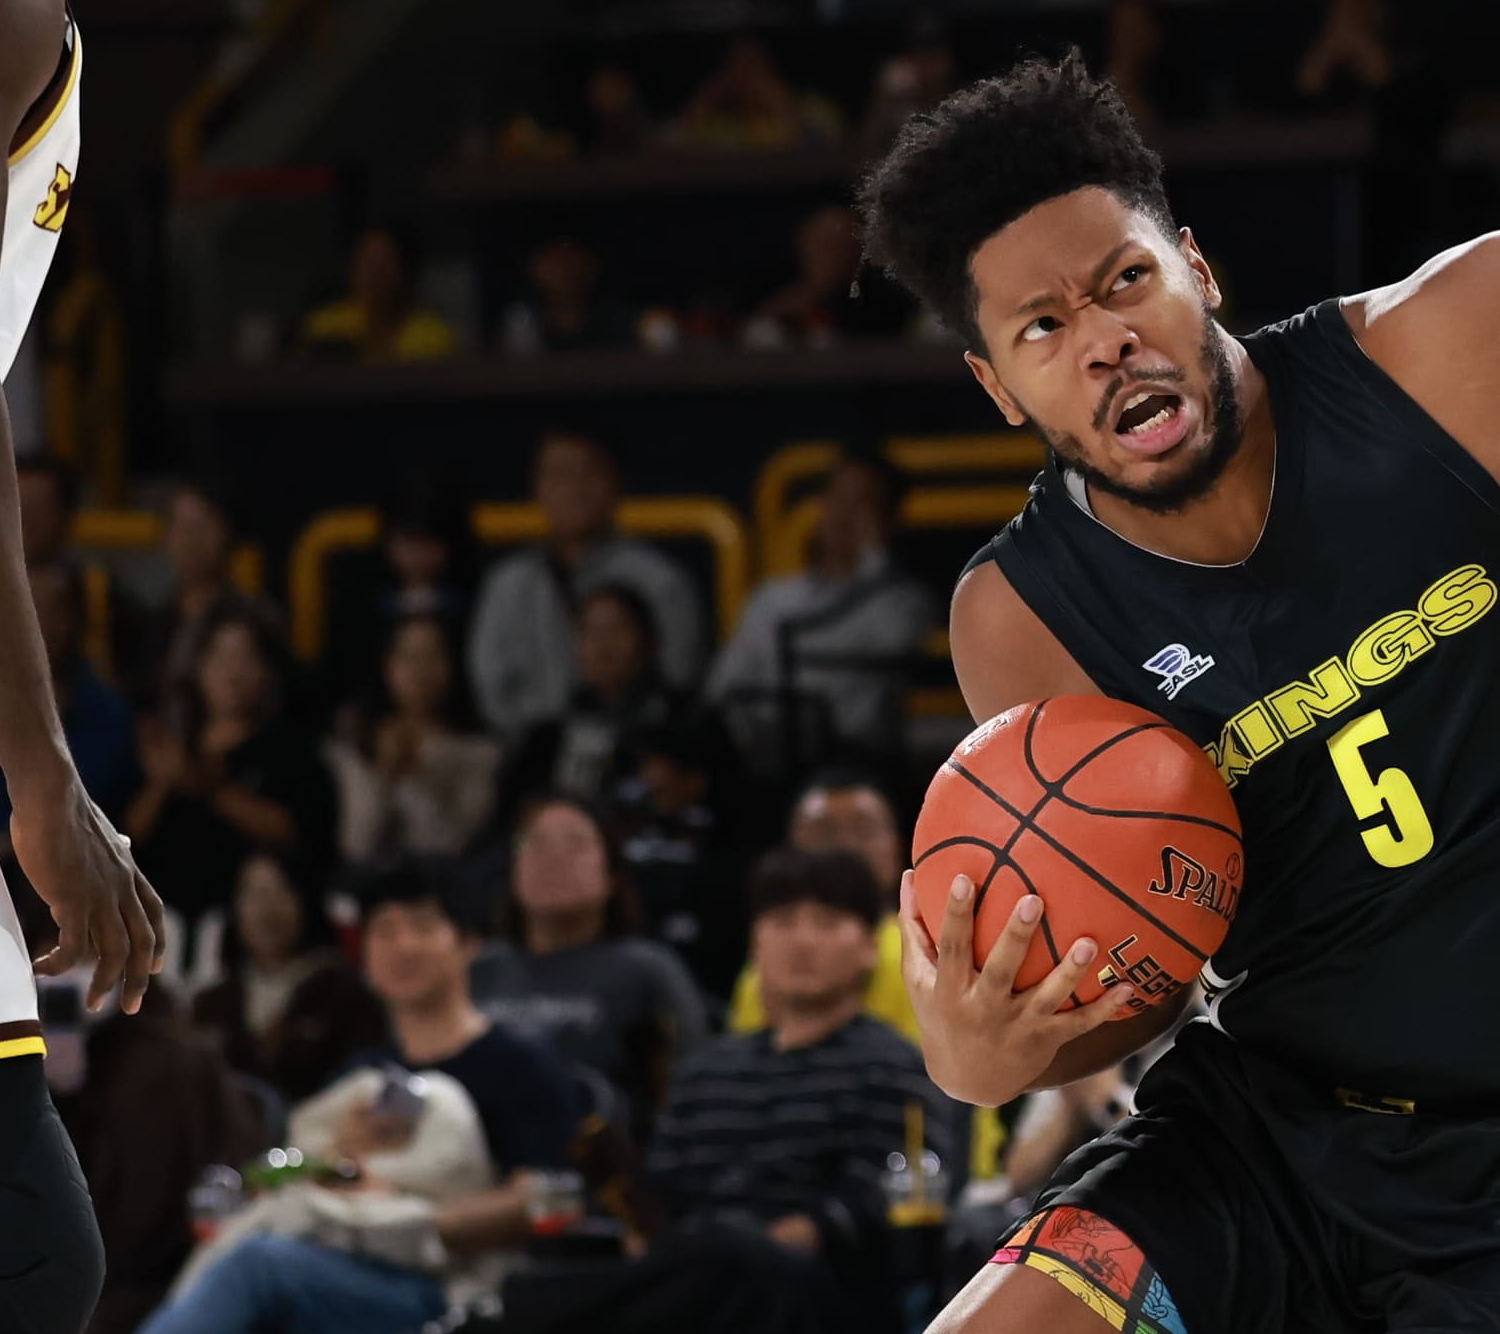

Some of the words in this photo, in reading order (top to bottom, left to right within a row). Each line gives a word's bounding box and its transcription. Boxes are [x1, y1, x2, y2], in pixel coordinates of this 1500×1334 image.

[1160, 656, 1214, 699] EASL
[1203, 563, 1499, 789] KINGS
[1326, 708, 1435, 869] 5
